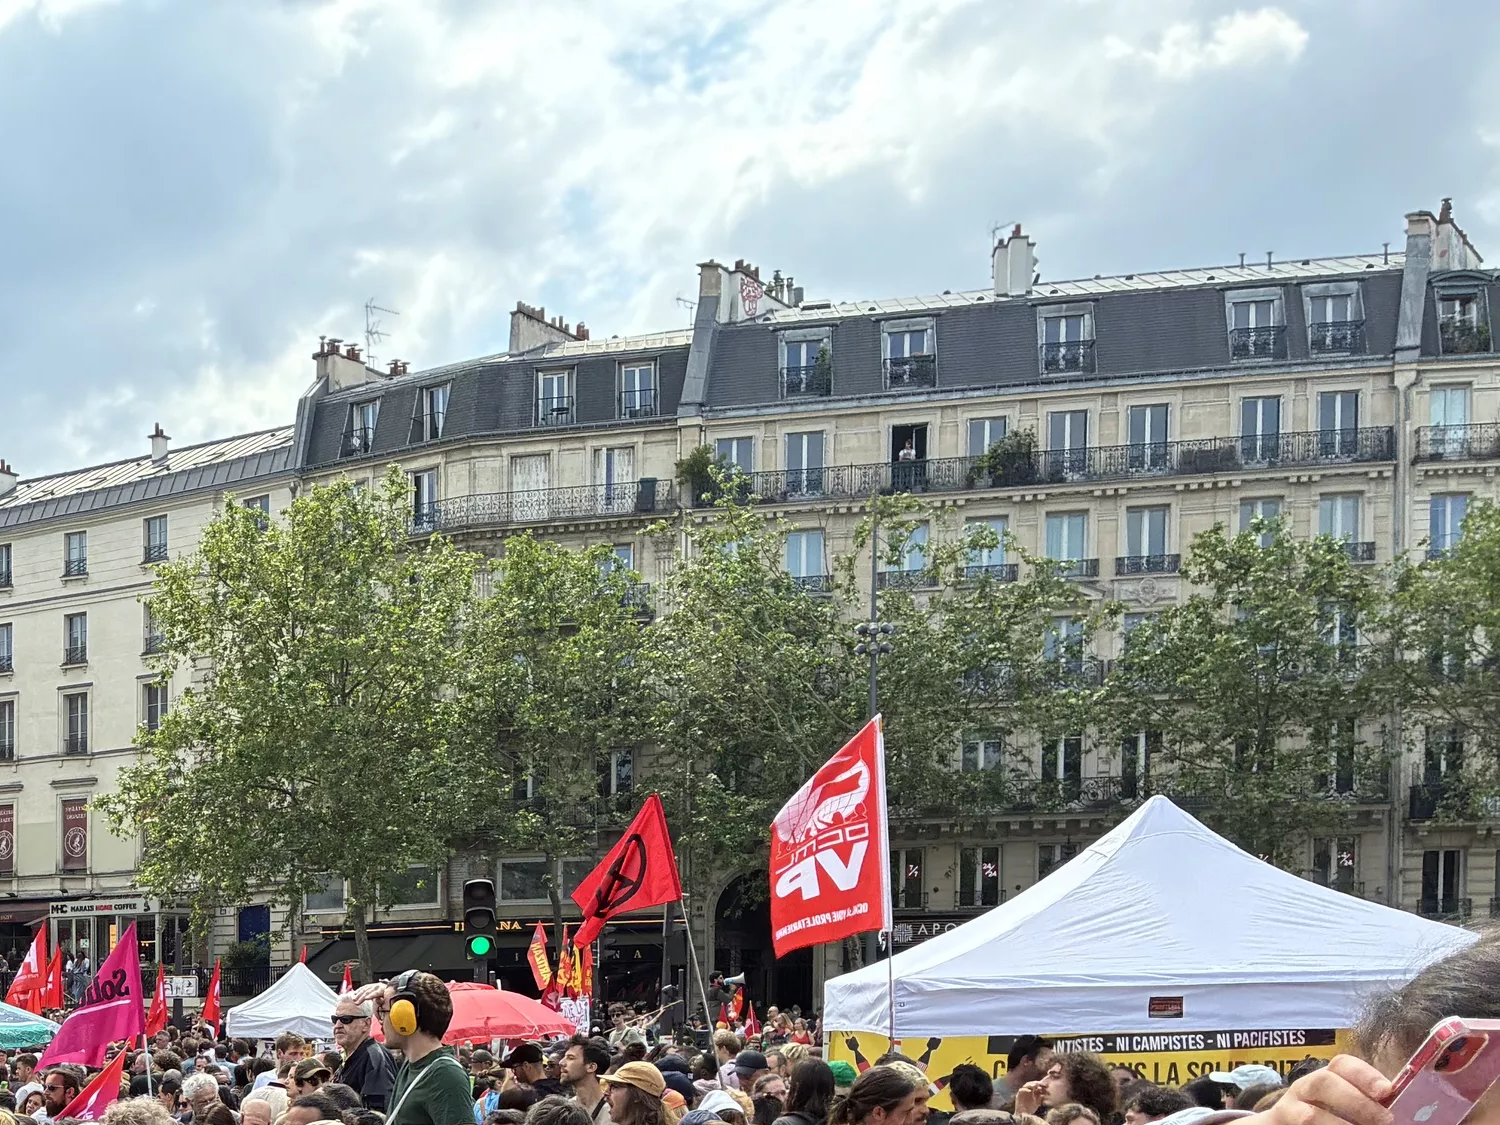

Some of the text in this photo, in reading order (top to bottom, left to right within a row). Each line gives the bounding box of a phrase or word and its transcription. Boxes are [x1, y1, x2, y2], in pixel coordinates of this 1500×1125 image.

[1116, 1037, 1130, 1051] NI
[1132, 1034, 1205, 1051] CAMPISTES
[1216, 1033, 1232, 1049] NI
[1233, 1029, 1306, 1049] PACIFISTES
